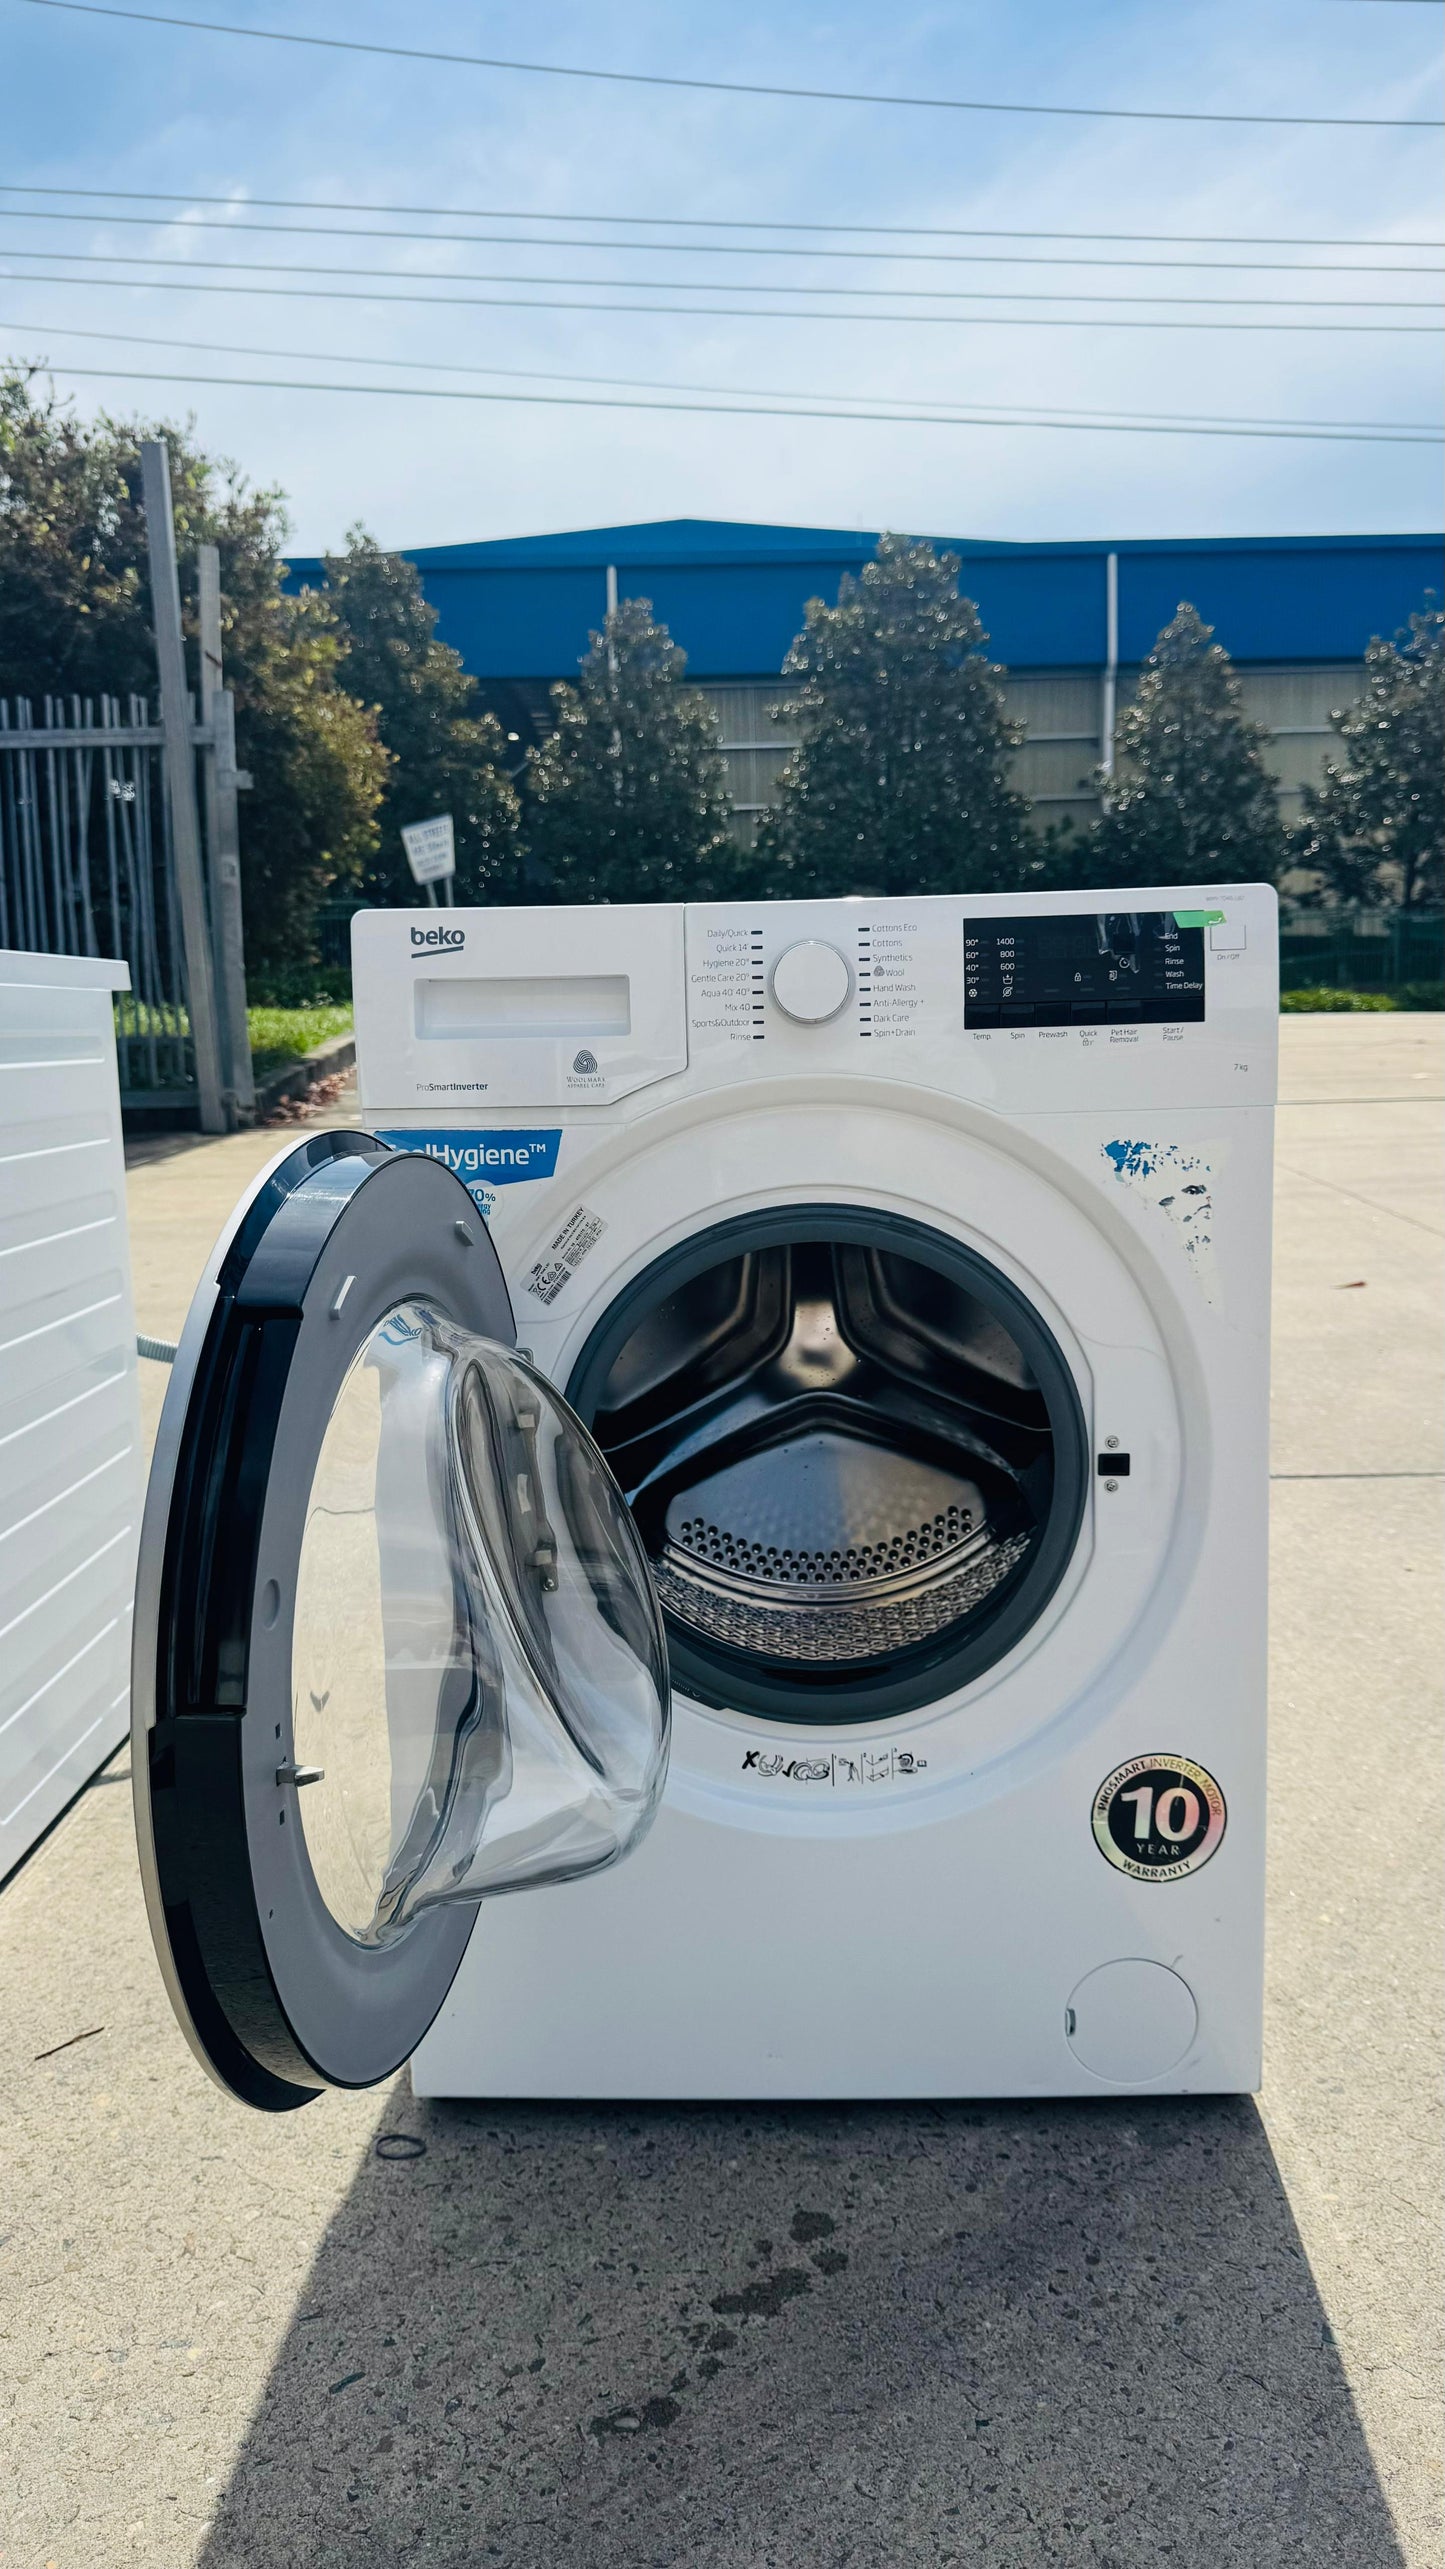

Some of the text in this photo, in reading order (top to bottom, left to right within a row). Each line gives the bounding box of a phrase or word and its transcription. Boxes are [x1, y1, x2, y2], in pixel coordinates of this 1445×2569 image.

[872, 924, 918, 932] Cottons Eco
[410, 926, 465, 946] beko
[708, 929, 748, 938] Daily/Quick
[872, 939, 902, 947] Cottons
[965, 938, 979, 946] 90°
[996, 938, 1014, 946] 1400
[716, 944, 737, 953] Quick
[1164, 944, 1180, 952] Spin
[872, 953, 912, 964] Synthetics
[703, 959, 734, 969] Hygiene
[692, 974, 716, 982] Gentle
[718, 974, 734, 982] Care
[873, 984, 893, 992] Hand
[1184, 982, 1203, 990] Delay
[739, 1003, 750, 1011] 40
[873, 998, 918, 1008] Anti-Allergy
[873, 1014, 910, 1022] Dark Care
[692, 1018, 750, 1028] Sports&Outdoor
[1010, 1032, 1026, 1040] Spin
[1079, 1030, 1098, 1038] Quick
[416, 1083, 488, 1091] ProSmartInverter
[552, 1234, 565, 1250] MADE
[567, 1207, 584, 1228] TURKEY
[1098, 1757, 1222, 1816] PROSMART INVERTER MOTOR
[1120, 1786, 1200, 1842] 10
[1136, 1844, 1180, 1856] YEAR
[1123, 1860, 1190, 1878] WARRANTY
